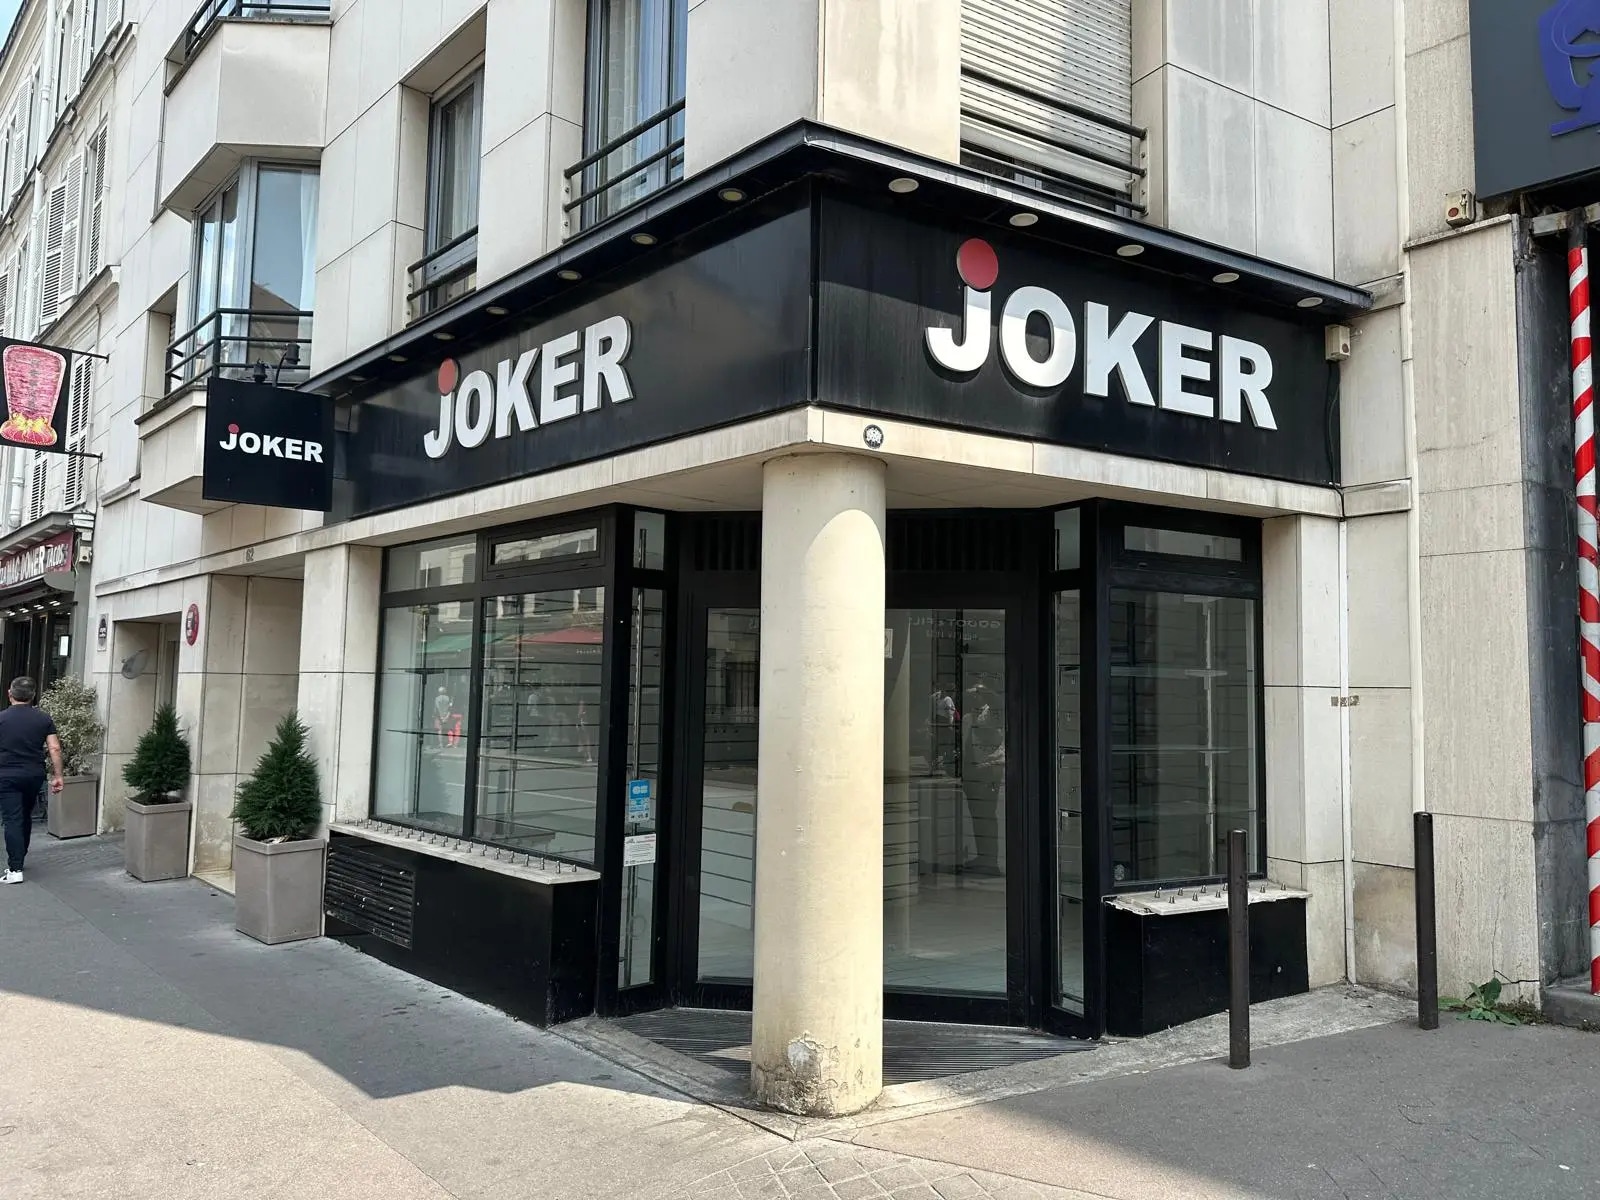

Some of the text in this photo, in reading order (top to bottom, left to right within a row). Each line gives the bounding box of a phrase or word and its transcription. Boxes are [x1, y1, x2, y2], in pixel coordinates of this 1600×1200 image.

[424, 315, 633, 458] JOKER
[925, 238, 1277, 430] JOKER
[219, 424, 323, 463] JOKER
